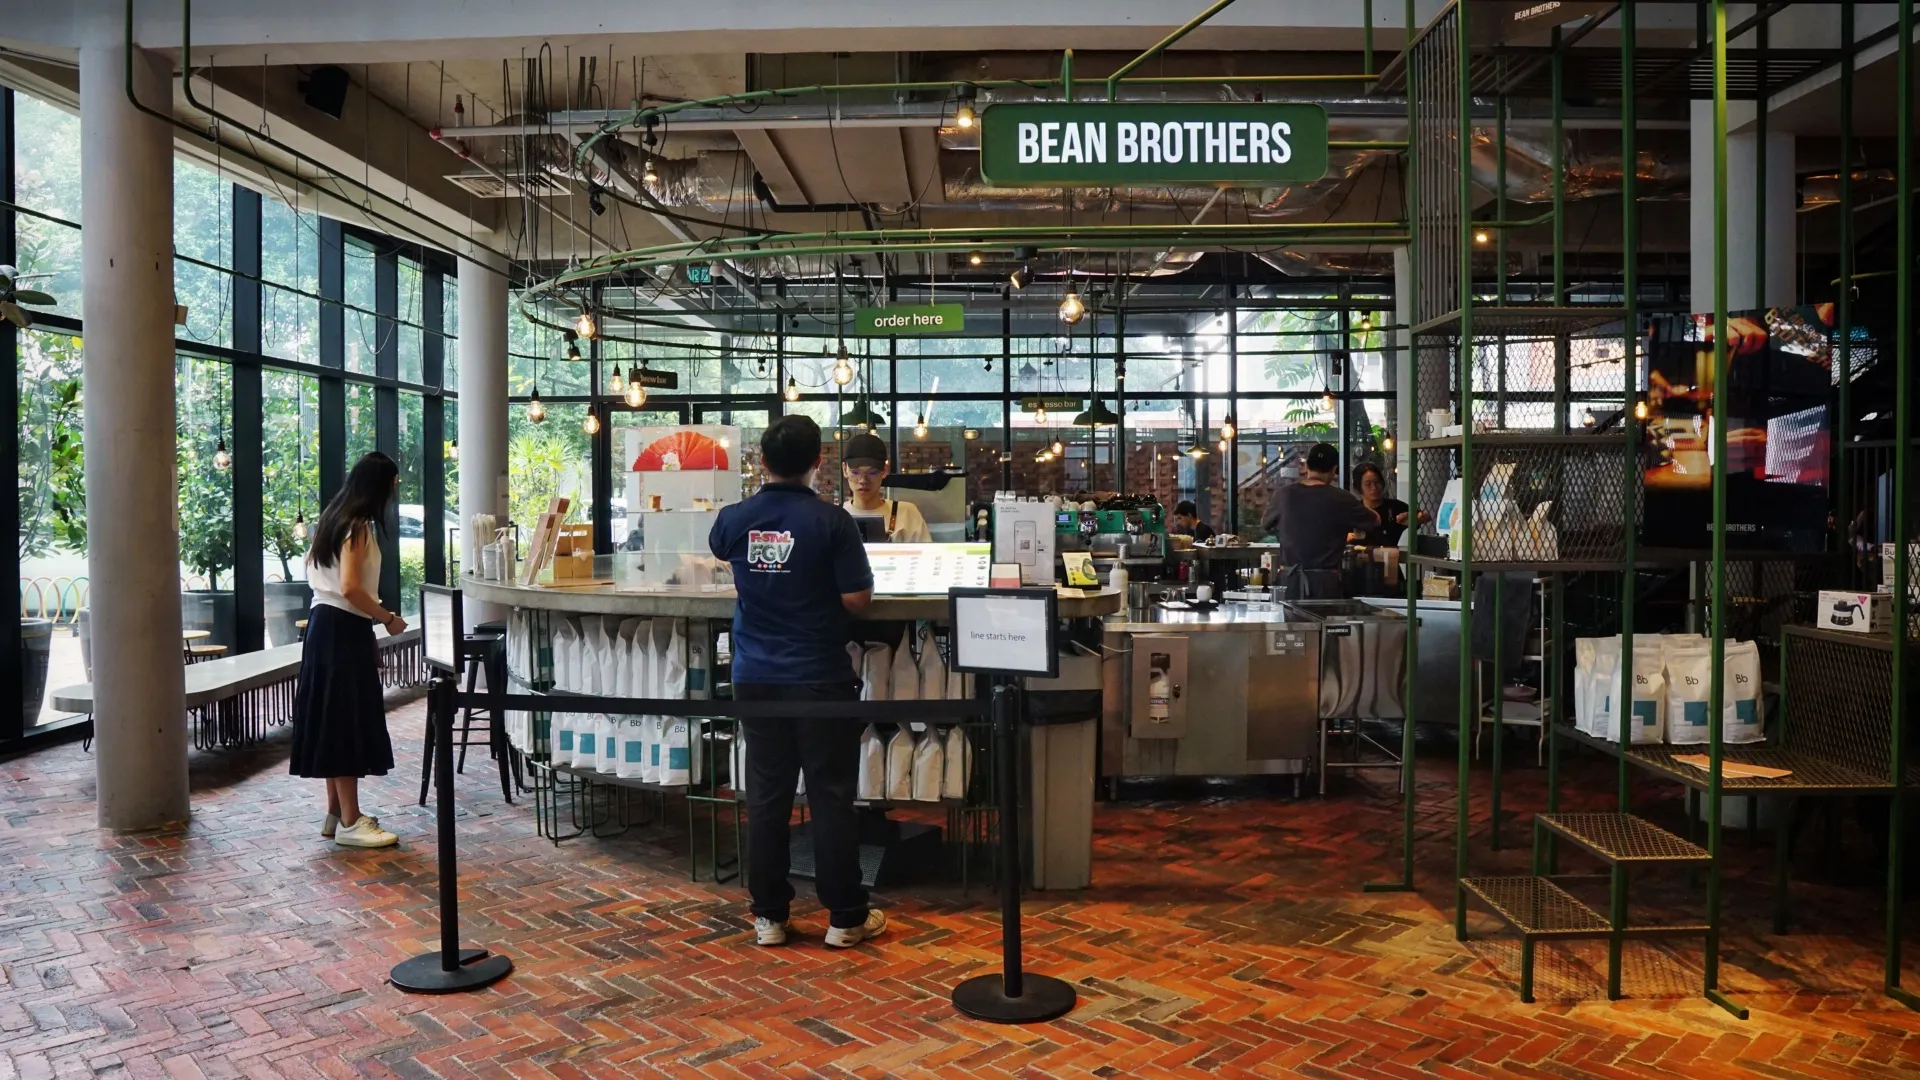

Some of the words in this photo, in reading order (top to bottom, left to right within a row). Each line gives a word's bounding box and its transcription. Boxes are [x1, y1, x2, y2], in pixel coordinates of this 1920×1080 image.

[1514, 9, 1530, 20] BEAN
[1531, 2, 1560, 15] BROTHERS
[1018, 121, 1107, 164] BEAN
[1117, 121, 1292, 164] BROTHERS
[874, 314, 910, 327] order
[913, 313, 943, 326] here
[750, 544, 791, 561] FGV
[970, 631, 984, 640] line
[986, 632, 1006, 641] starts
[1008, 633, 1026, 642] here
[692, 646, 702, 654] Bb
[1636, 675, 1648, 685] Bb
[1685, 676, 1699, 686] Bb
[1735, 674, 1749, 684] Bb
[630, 719, 642, 727] Bb
